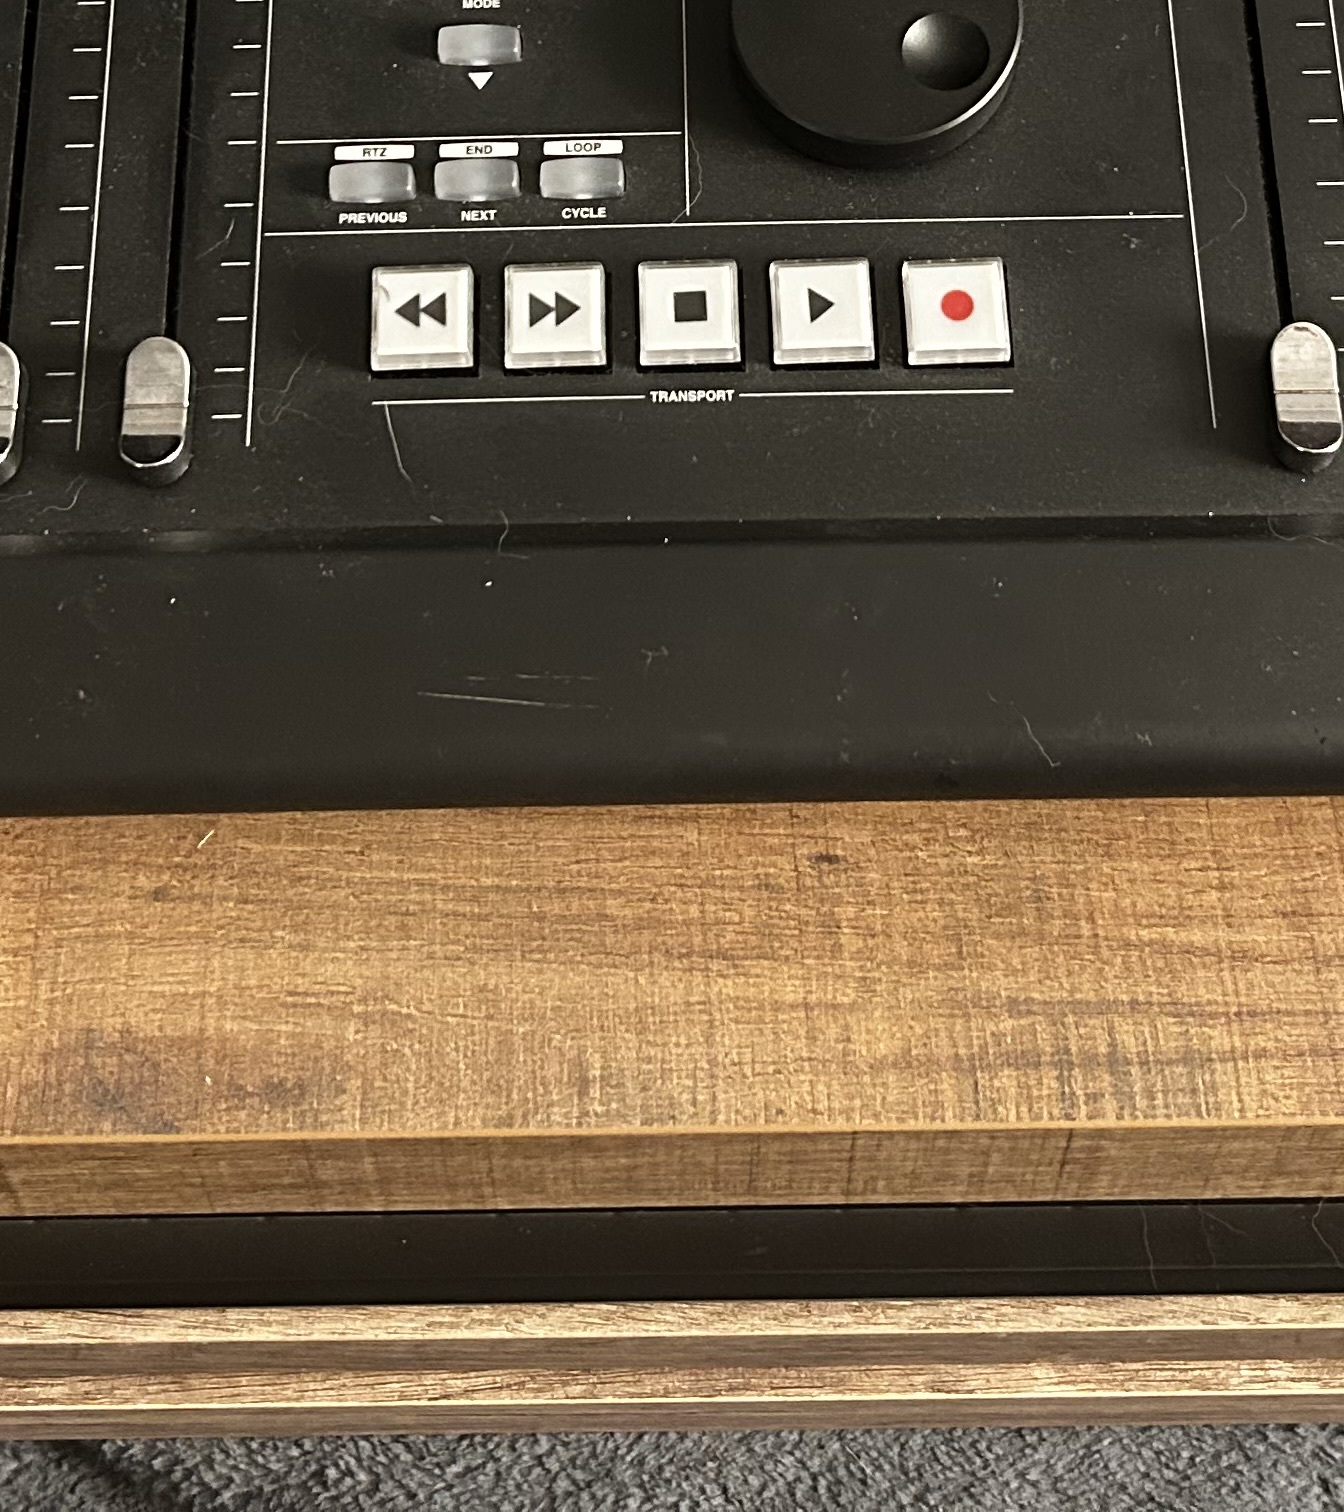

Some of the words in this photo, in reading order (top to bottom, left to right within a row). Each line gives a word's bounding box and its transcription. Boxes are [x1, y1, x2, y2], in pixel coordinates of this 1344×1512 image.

[362, 147, 387, 157] RTZ
[465, 144, 493, 154] END
[565, 142, 602, 152] LOOP
[339, 211, 407, 224] PREVIOUS
[460, 209, 497, 220] NEXT
[562, 207, 607, 219] CYCLE
[650, 390, 734, 402] TRANSPORT
